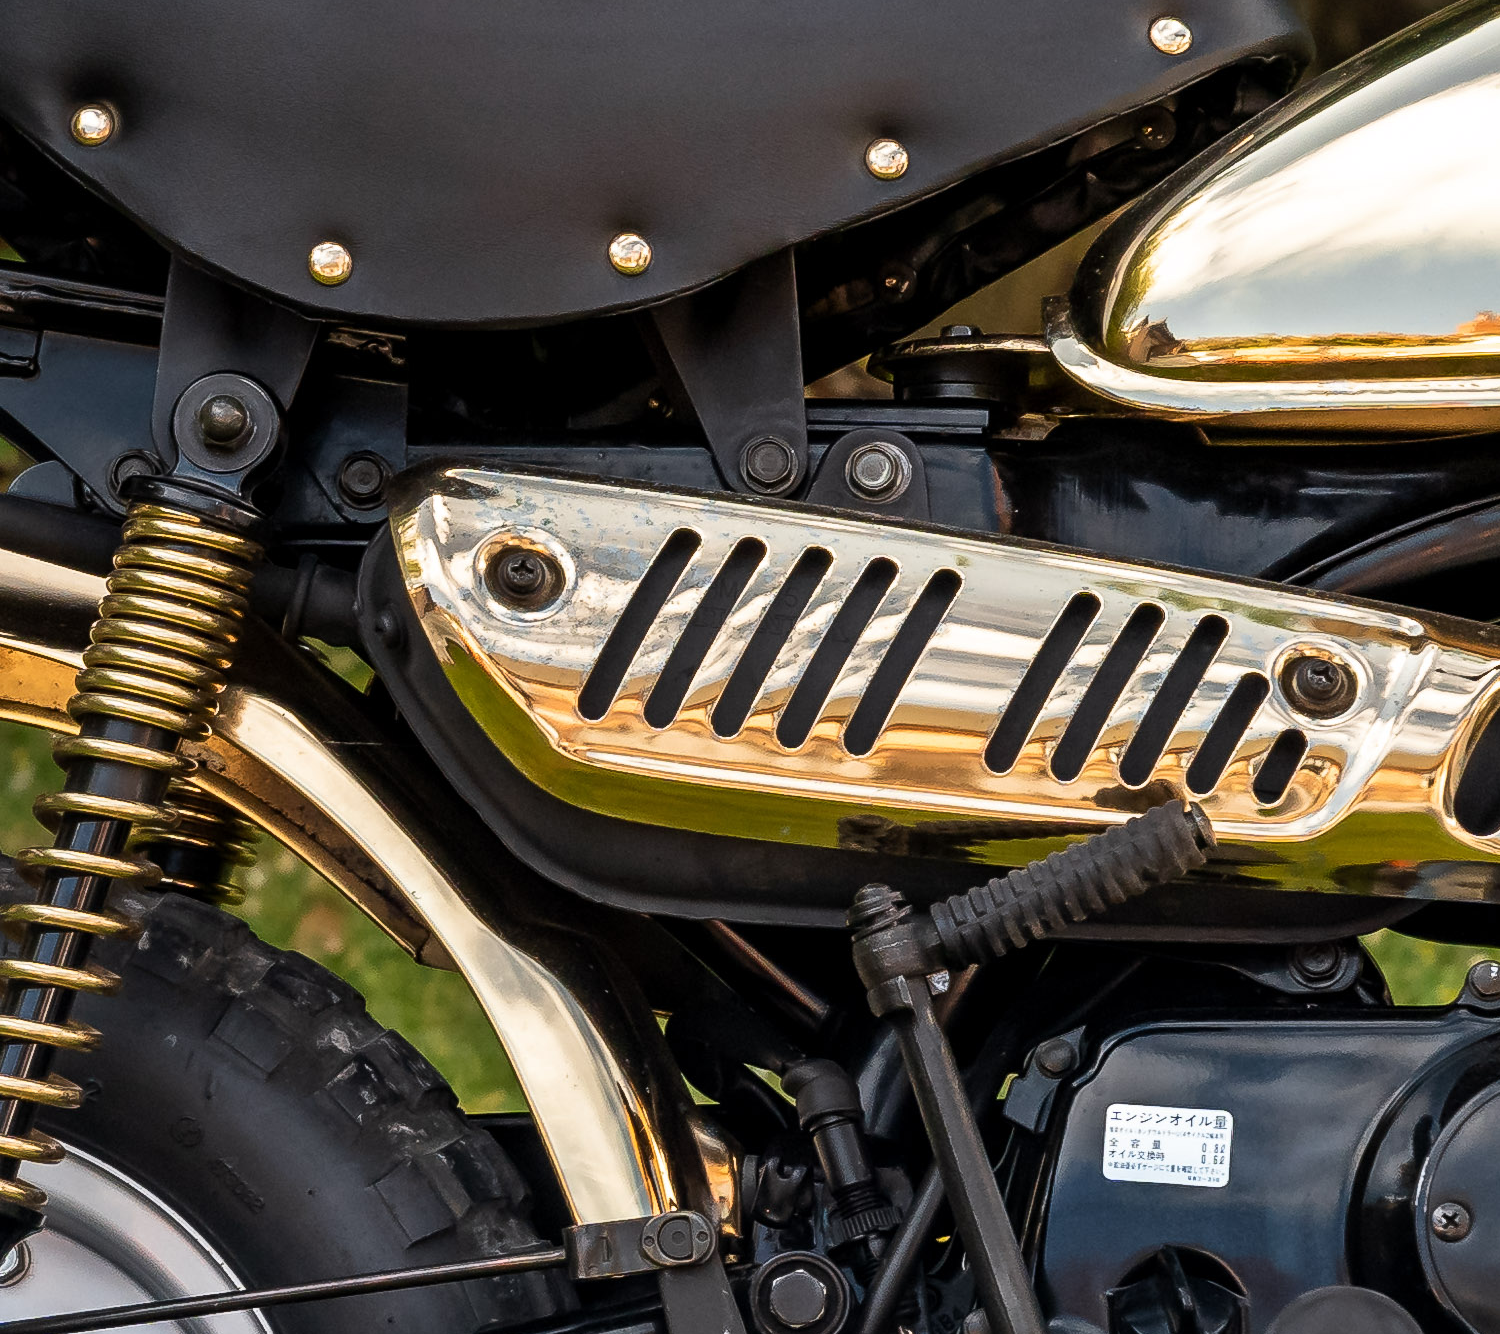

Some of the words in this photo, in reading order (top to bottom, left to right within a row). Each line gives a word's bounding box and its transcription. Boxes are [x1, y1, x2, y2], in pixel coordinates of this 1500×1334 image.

[1110, 1110, 1228, 1130] エンジンオイル量
